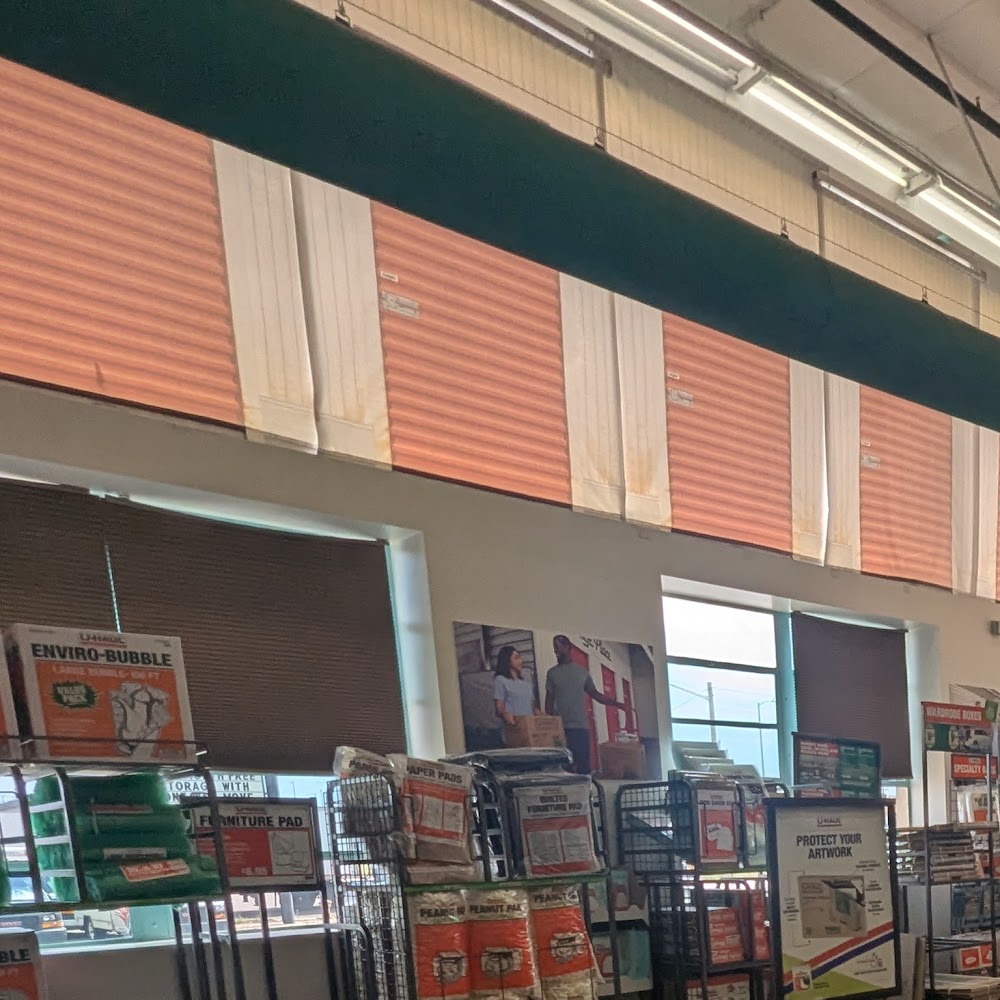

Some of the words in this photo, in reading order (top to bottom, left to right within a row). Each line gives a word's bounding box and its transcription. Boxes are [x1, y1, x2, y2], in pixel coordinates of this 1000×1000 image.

[31, 643, 173, 667] ENVIRO-BUBBLE
[168, 782, 208, 791] TORAG
[221, 782, 250, 792] WITH
[200, 815, 274, 828] FRNITURE
[278, 815, 304, 828] PAD
[796, 834, 838, 847] PROTECT
[839, 833, 862, 845] YOUR
[808, 847, 853, 860] ARTWORK
